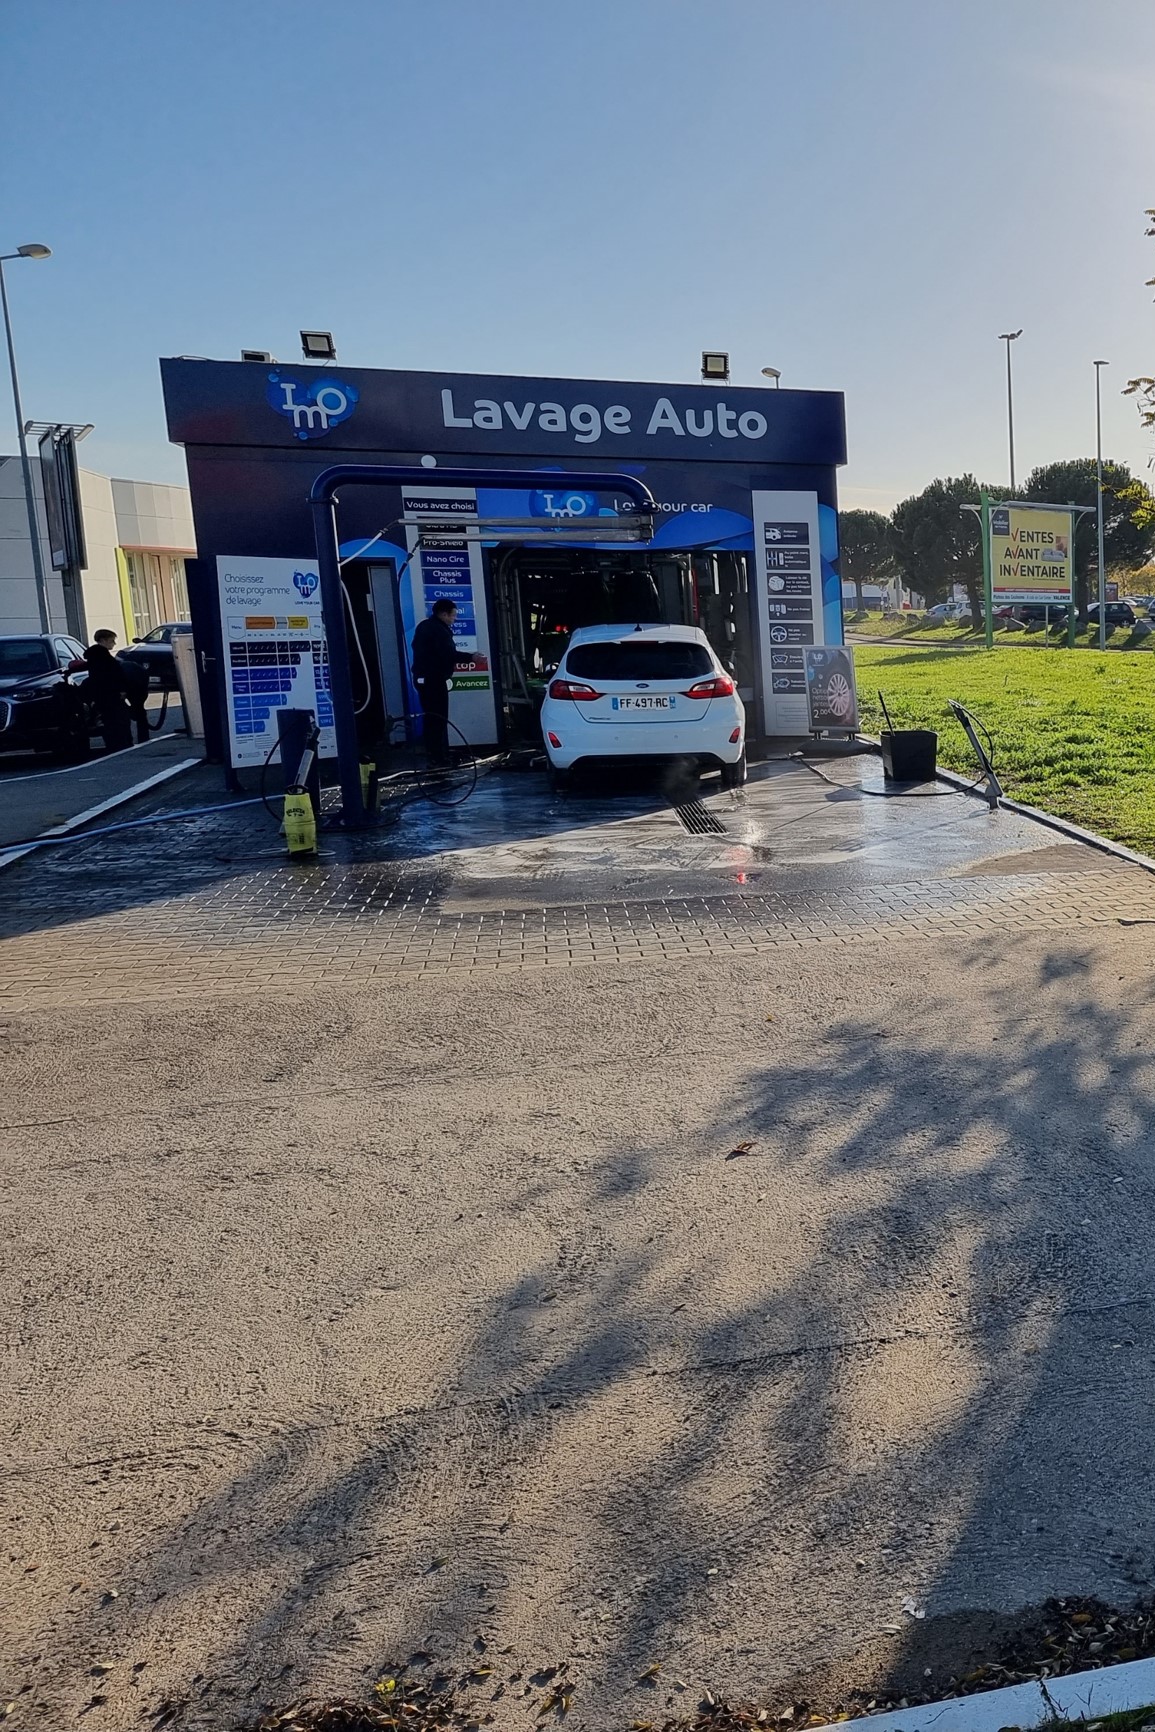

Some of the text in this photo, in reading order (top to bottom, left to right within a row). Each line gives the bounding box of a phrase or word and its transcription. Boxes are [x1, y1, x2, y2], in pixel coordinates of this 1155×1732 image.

[441, 389, 768, 443] Lavage Auto
[406, 501, 429, 509] Vous
[451, 502, 475, 510] choisi
[690, 503, 713, 513] car
[448, 555, 465, 563] Cire
[224, 573, 264, 583] Choisissez
[225, 586, 290, 596] votre programme
[434, 590, 464, 598] Chassis
[226, 595, 262, 606] de lavage
